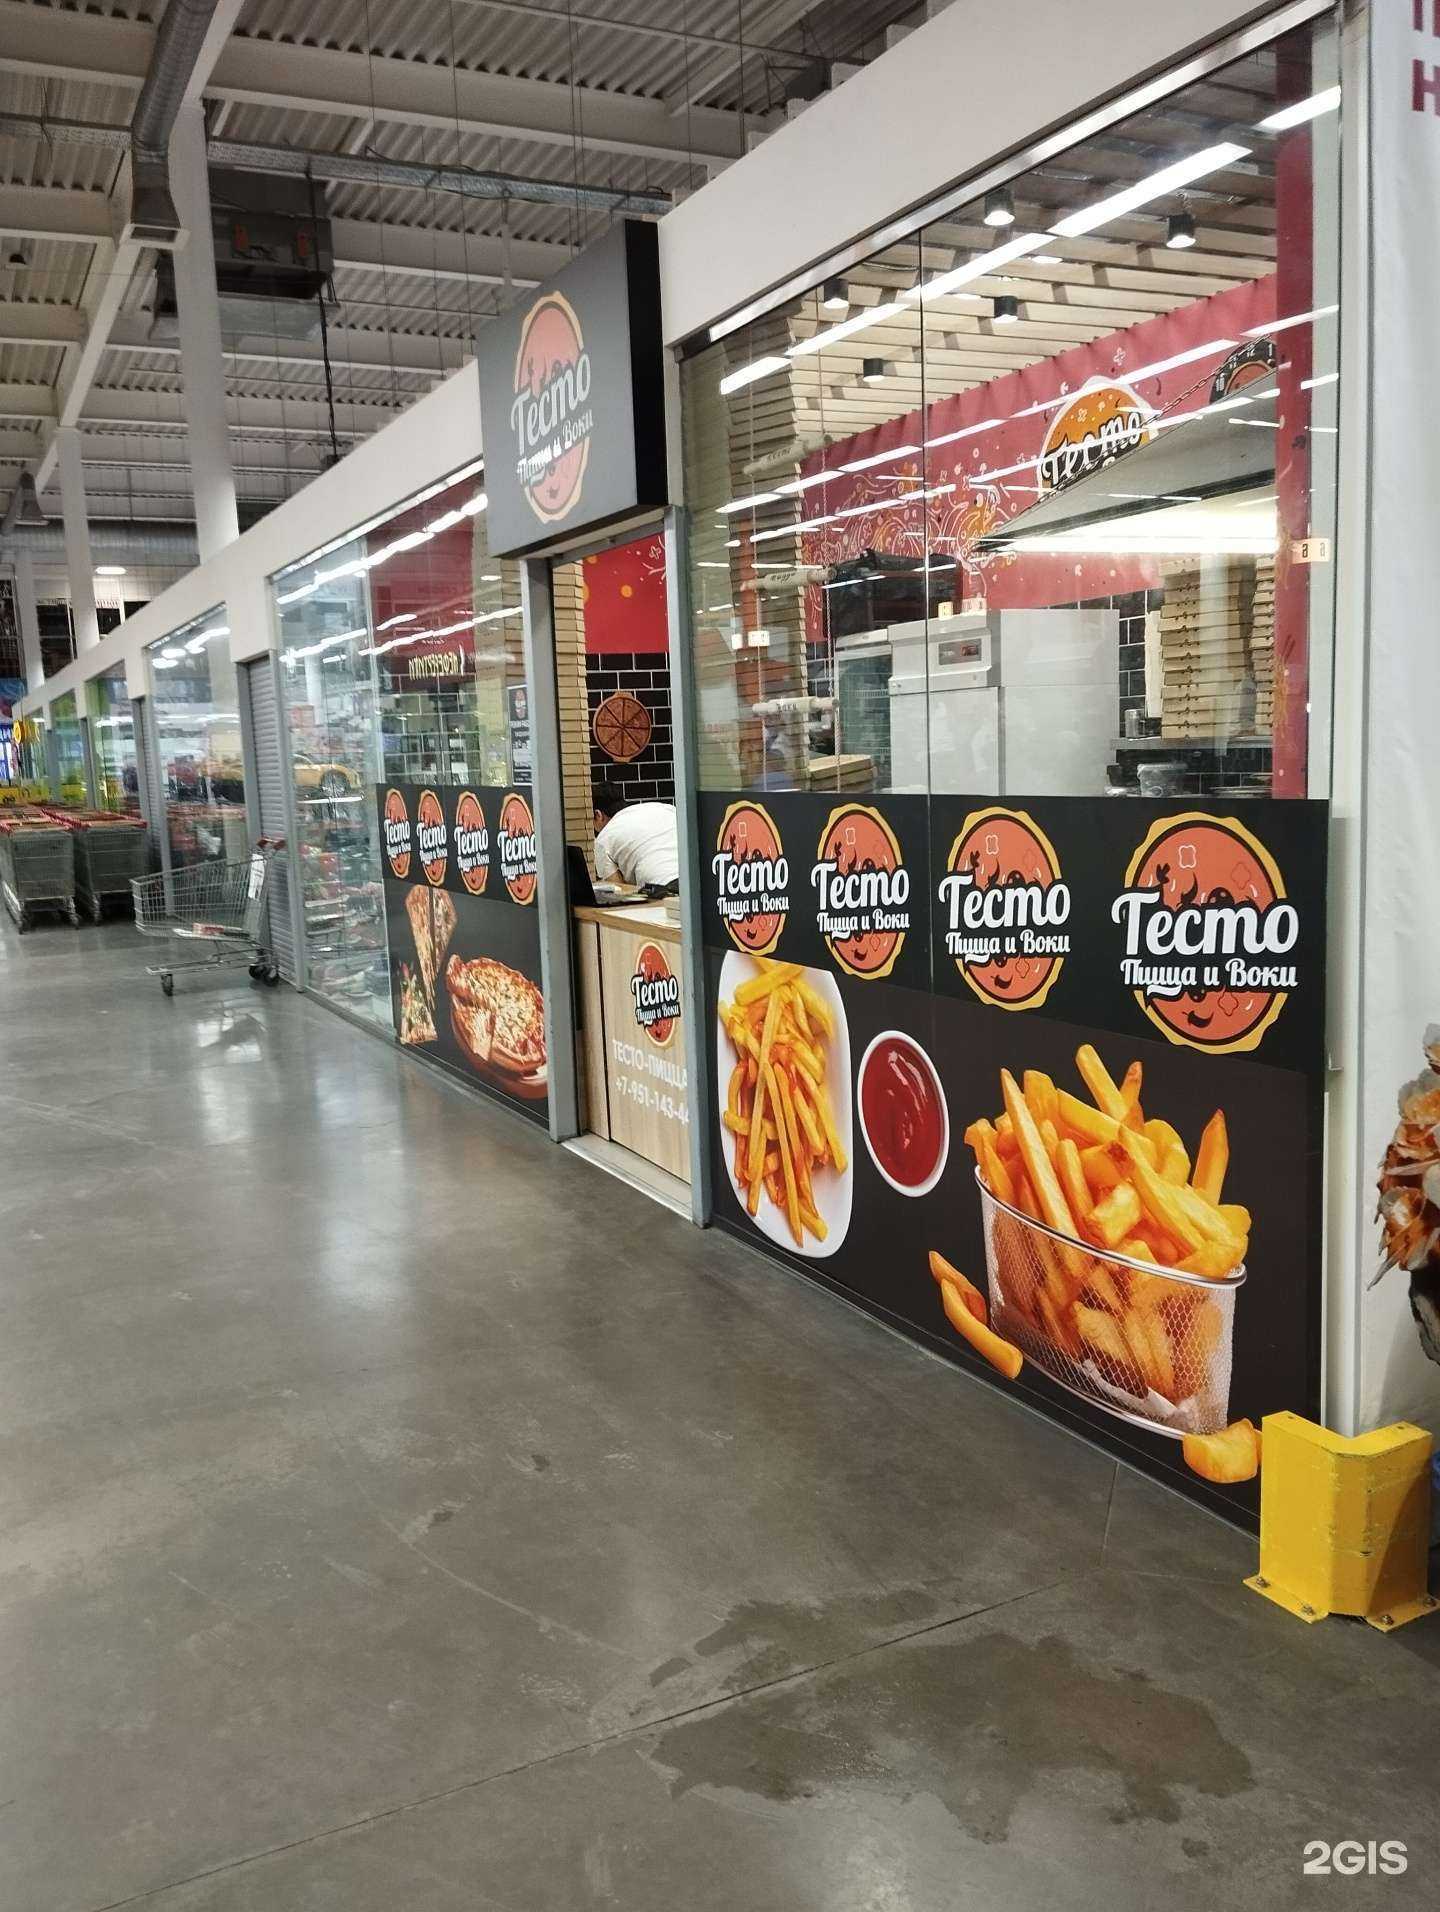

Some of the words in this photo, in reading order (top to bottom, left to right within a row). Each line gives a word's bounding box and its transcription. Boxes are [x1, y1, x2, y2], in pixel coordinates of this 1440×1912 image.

[511, 353, 591, 457] Тесто
[384, 819, 411, 845] Тесто
[417, 823, 447, 850] Тесто
[454, 826, 489, 856] Тесто
[712, 852, 789, 896] Тесто
[810, 862, 910, 911] Тесто
[717, 897, 750, 921] Пицца
[752, 899, 759, 912] и
[760, 892, 790, 911] Воки
[938, 874, 1071, 930] Тесто
[816, 912, 858, 940] Пицца
[861, 914, 870, 931] и
[872, 908, 910, 929] Воки
[1111, 892, 1300, 956] Тесто
[945, 931, 1001, 964] Пицца
[1004, 936, 1017, 954] и
[1019, 929, 1071, 953] Воки
[631, 976, 678, 1008] Тесто
[1120, 958, 1197, 997] Пицца
[1203, 966, 1220, 986] и
[1225, 957, 1299, 987] Воки
